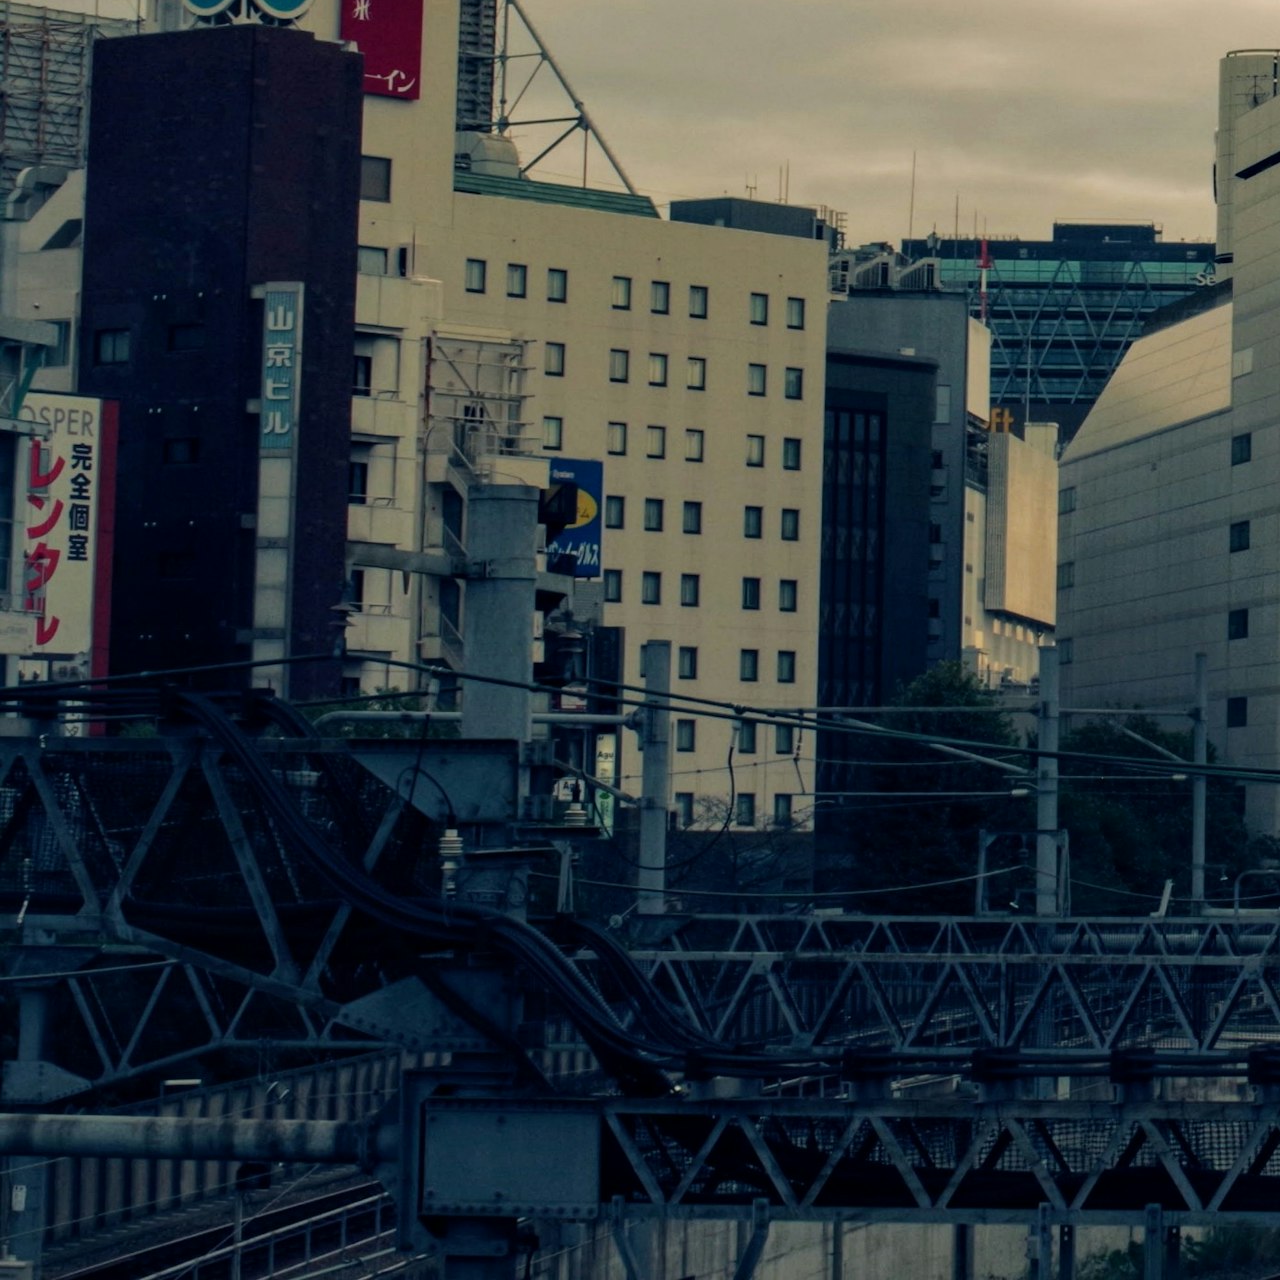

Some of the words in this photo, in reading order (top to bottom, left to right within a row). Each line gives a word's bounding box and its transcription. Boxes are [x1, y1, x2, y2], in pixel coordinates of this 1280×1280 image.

[263, 305, 294, 435] 山京ビル
[26, 438, 65, 645] レンタル
[67, 442, 93, 562] 完全個室
